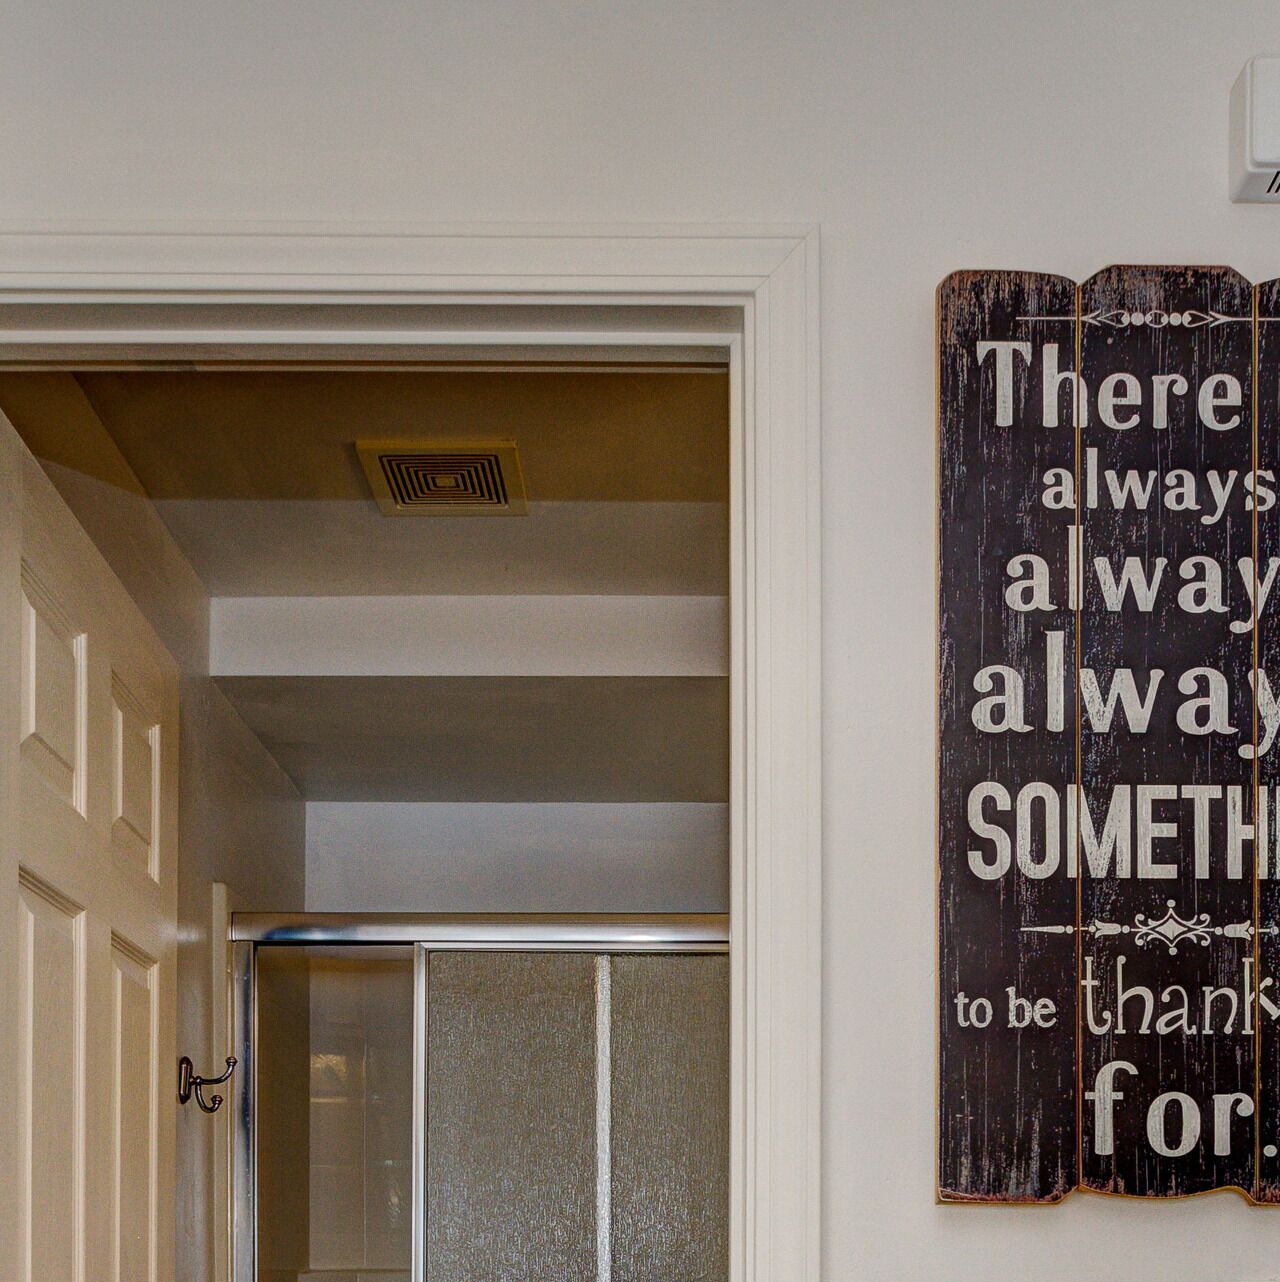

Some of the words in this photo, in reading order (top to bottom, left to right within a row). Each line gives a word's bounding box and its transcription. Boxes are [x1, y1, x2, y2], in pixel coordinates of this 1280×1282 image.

[976, 340, 1243, 431] There
[953, 990, 993, 1029] to
[1004, 986, 1058, 1029] be
[1084, 1060, 1278, 1158] for.
